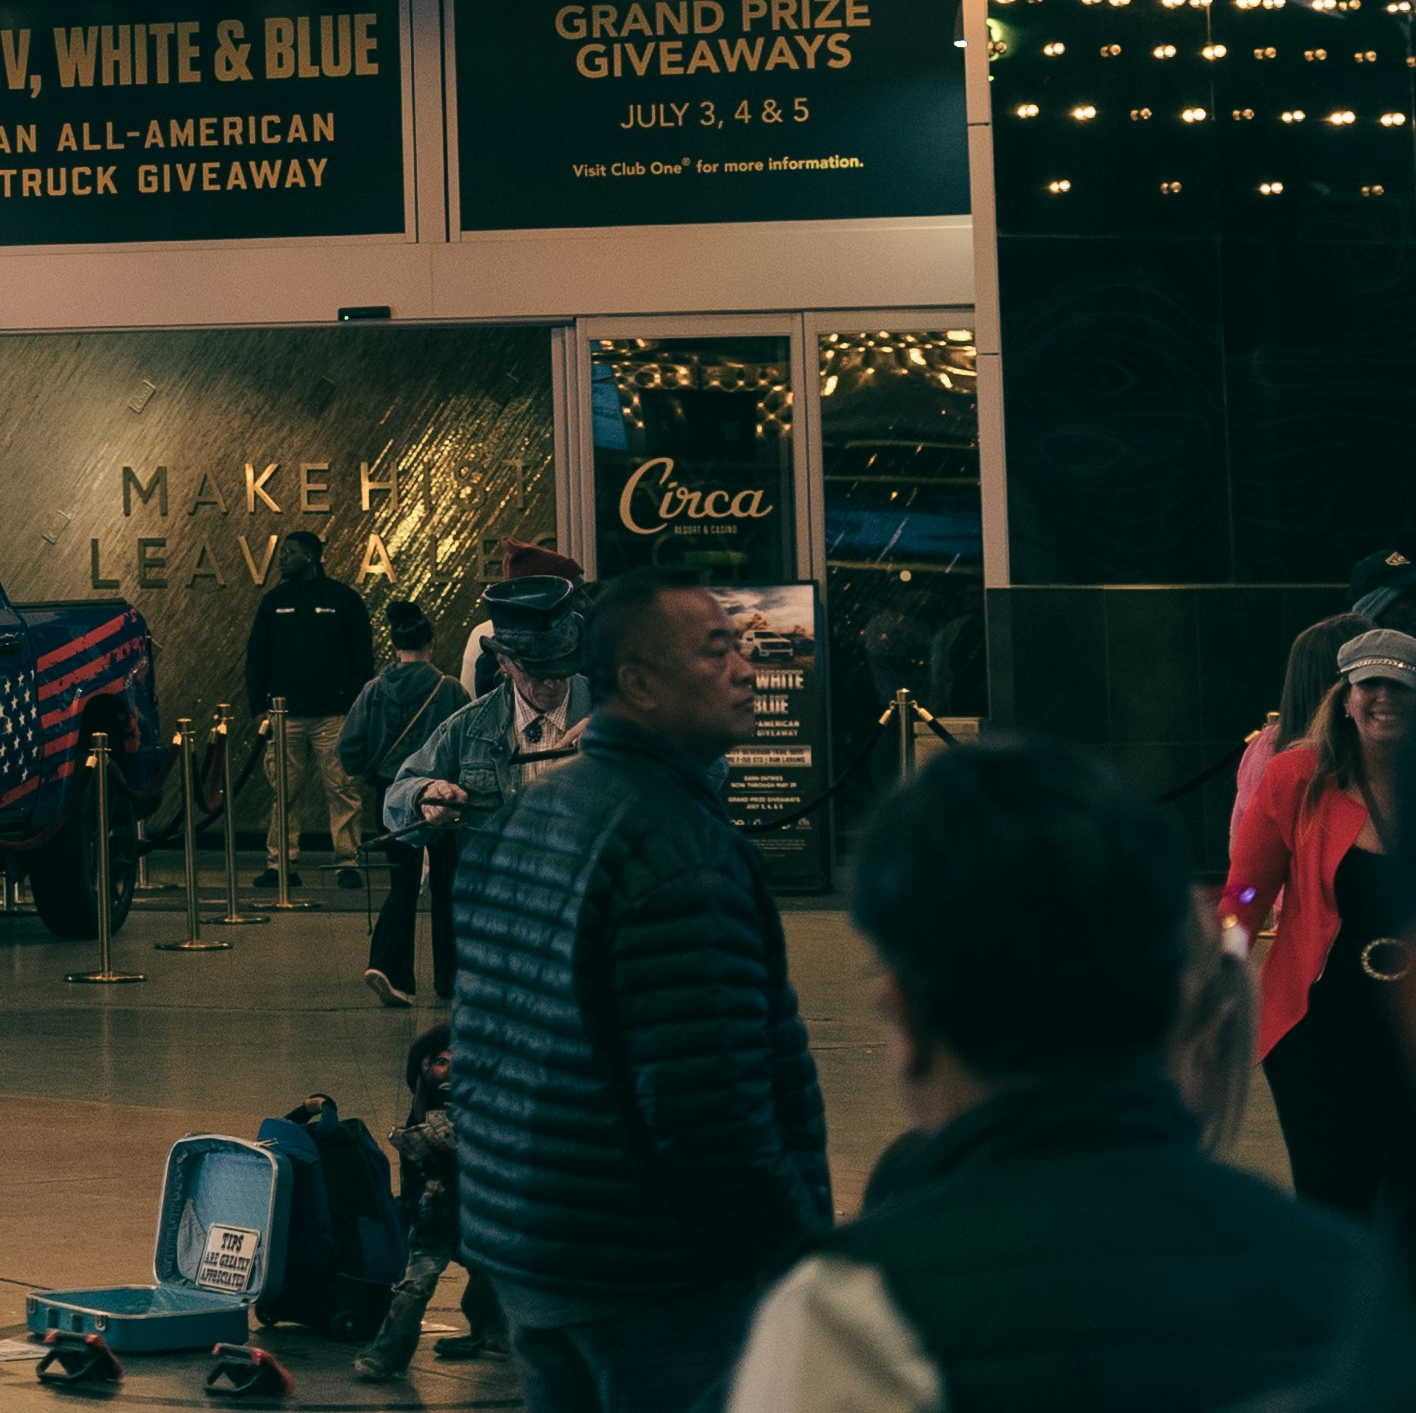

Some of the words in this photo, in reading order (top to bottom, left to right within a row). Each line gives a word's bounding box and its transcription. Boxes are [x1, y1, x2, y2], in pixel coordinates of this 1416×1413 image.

[554, 0, 725, 40] GRAND
[53, 21, 201, 88] WHITE
[214, 19, 253, 82] &
[264, 13, 379, 79] BLUE
[575, 33, 852, 79] GIVEAWAYS
[620, 102, 689, 129] JULY
[699, 101, 724, 129] 3,
[734, 99, 752, 124] 4
[761, 98, 784, 123] &
[793, 97, 810, 122] 5
[57, 112, 335, 152] ALL-AMERICAN
[138, 158, 329, 193] GIVEAWAY
[572, 163, 606, 177] Visit
[611, 161, 646, 177] Club
[696, 159, 719, 173] for
[724, 160, 764, 173] more
[768, 154, 864, 171] information.
[121, 461, 331, 518] MAKE
[619, 457, 774, 535] Circa
[674, 524, 701, 534] RESORT
[710, 524, 738, 534] CASINO
[89, 534, 279, 590] LEAV
[355, 533, 398, 585] A
[755, 669, 804, 690] WHITE
[221, 1233, 245, 1253] TIPS
[200, 1268, 246, 1288] APPRECIATED
[204, 1252, 220, 1265] ARE
[219, 1253, 251, 1272] GREATLY
